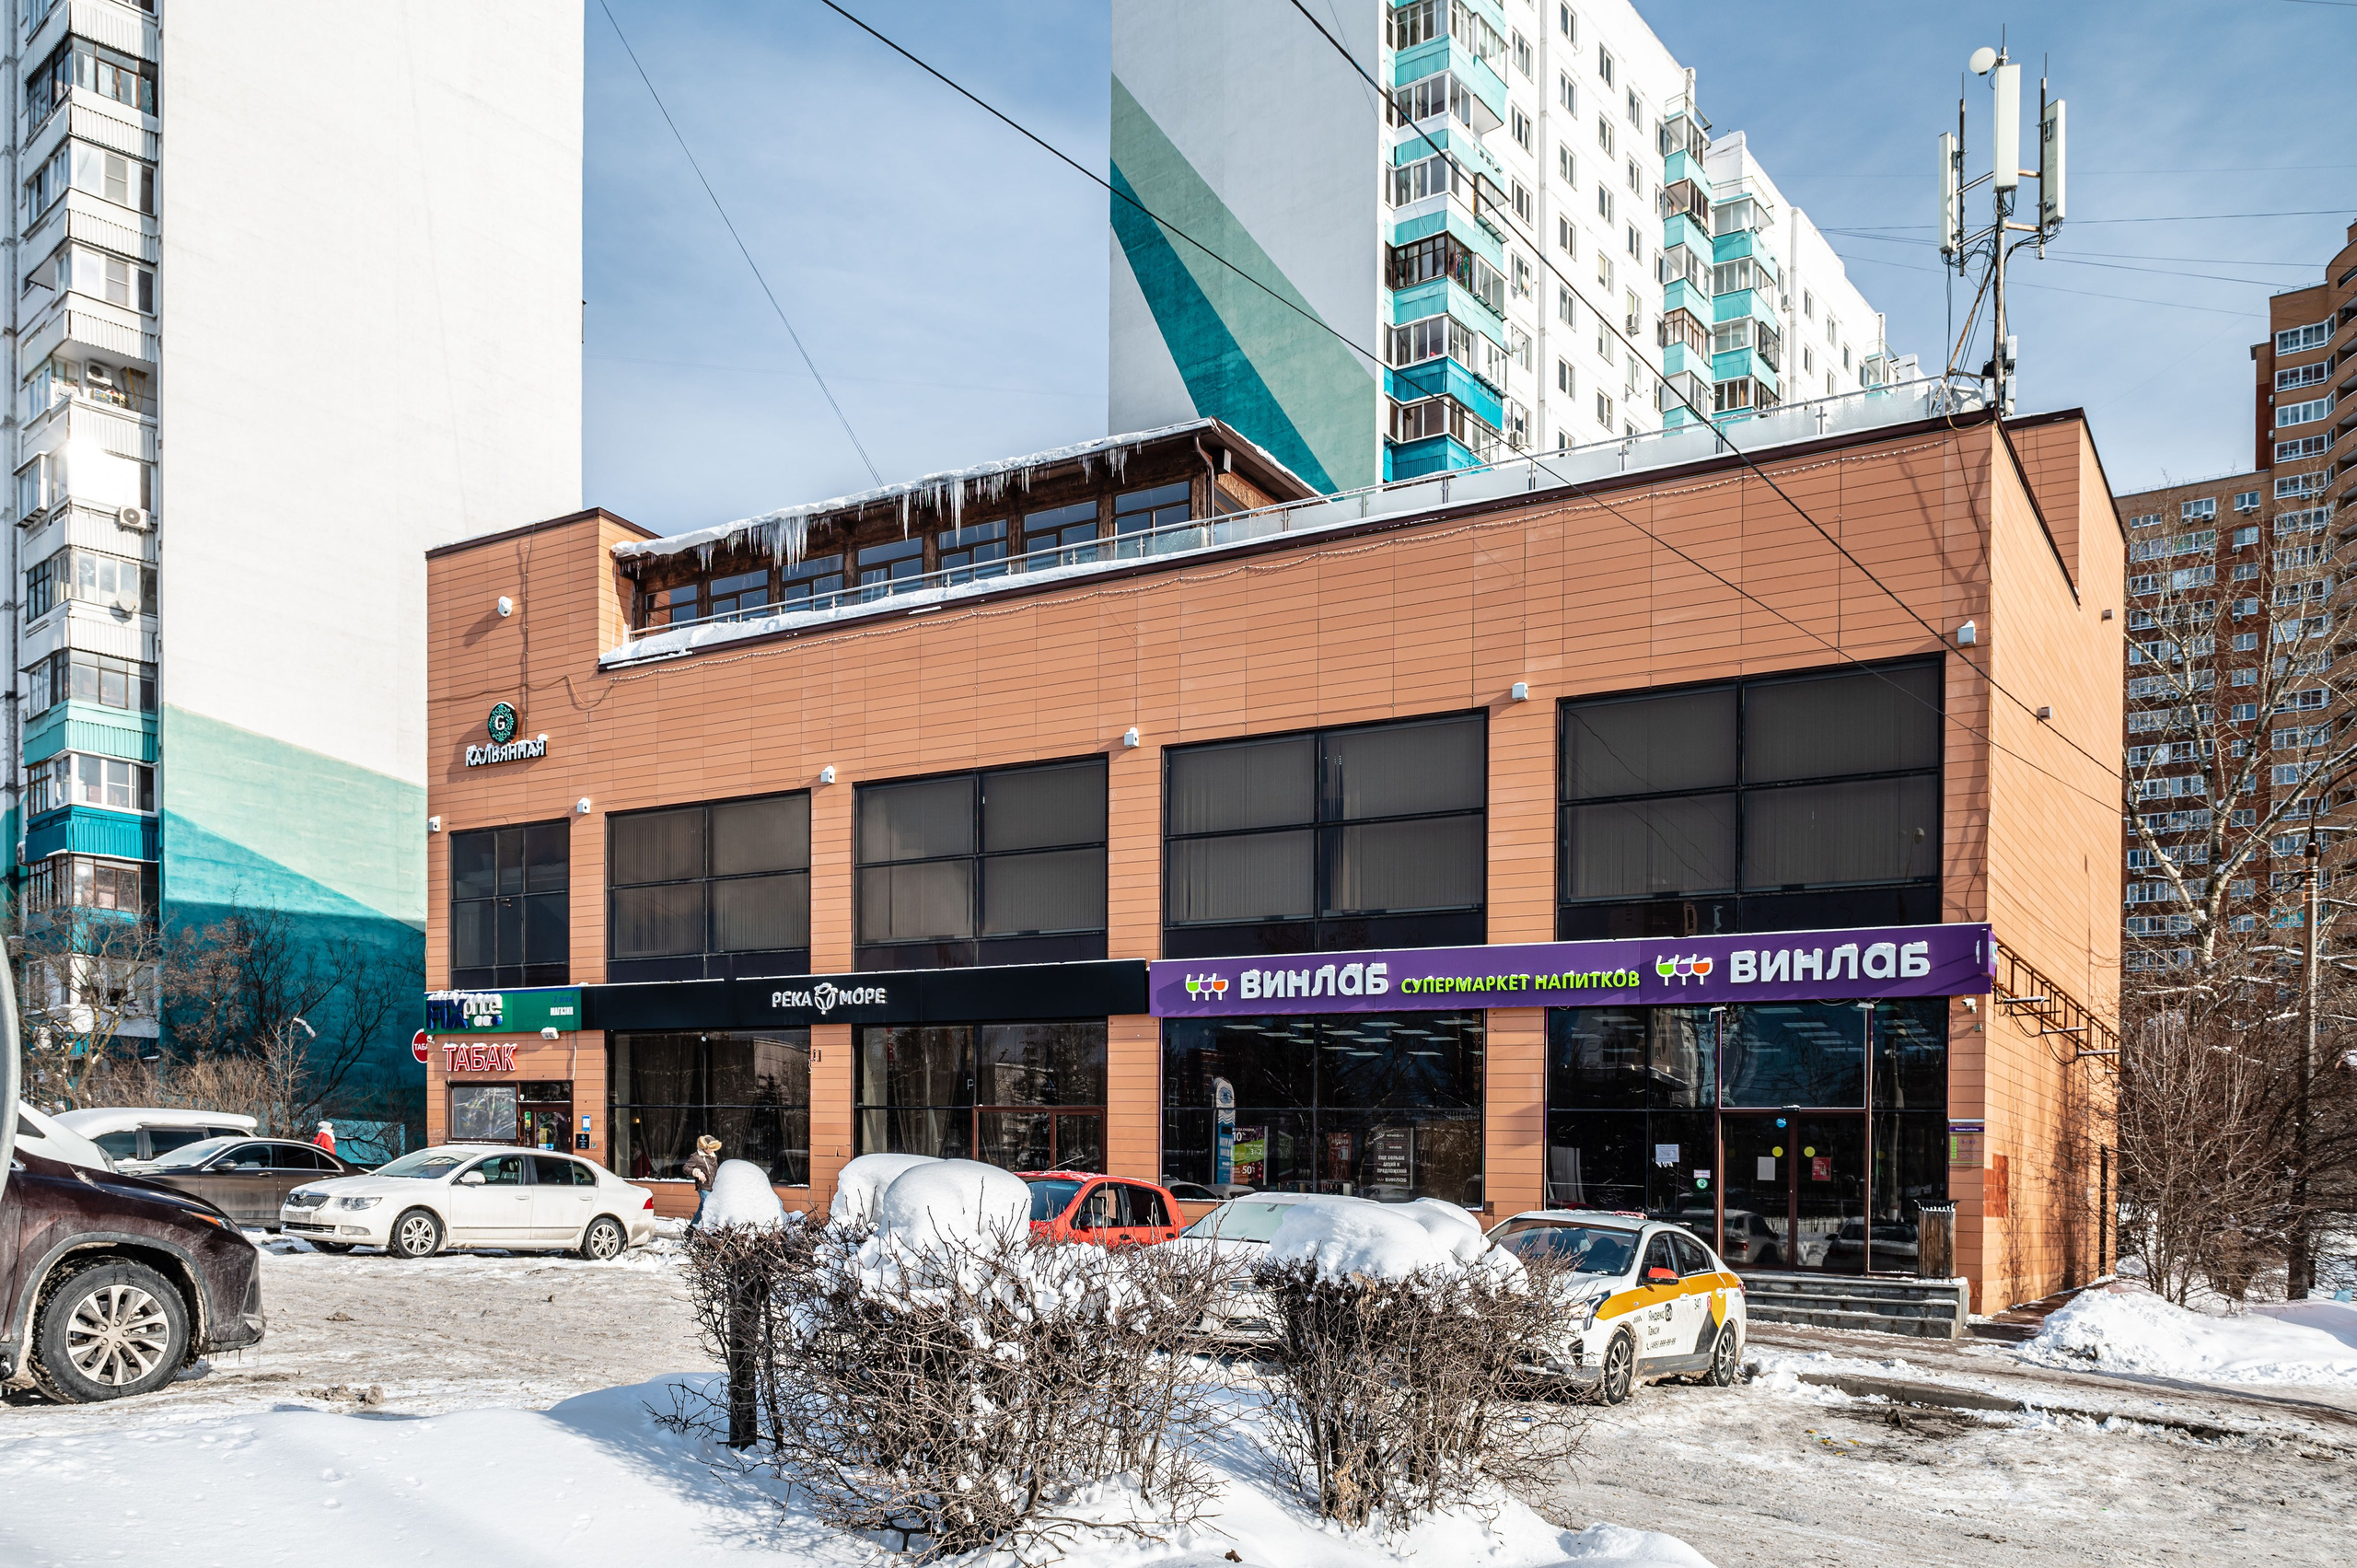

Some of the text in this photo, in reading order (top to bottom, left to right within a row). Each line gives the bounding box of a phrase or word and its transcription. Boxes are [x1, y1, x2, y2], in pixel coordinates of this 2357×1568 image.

[494, 715, 505, 731] G
[1240, 941, 1931, 1000] ВИНЛАБ СУПЕРМАРКЕТ НАПИТКОВ ВИНЛАБ
[772, 987, 888, 1007] РЕКА МОРЕ
[426, 997, 503, 1029] FIX price
[550, 1006, 574, 1016] МАГАЗИН
[442, 1044, 517, 1072] ТАБАК
[1648, 1326, 1660, 1336] Такси
